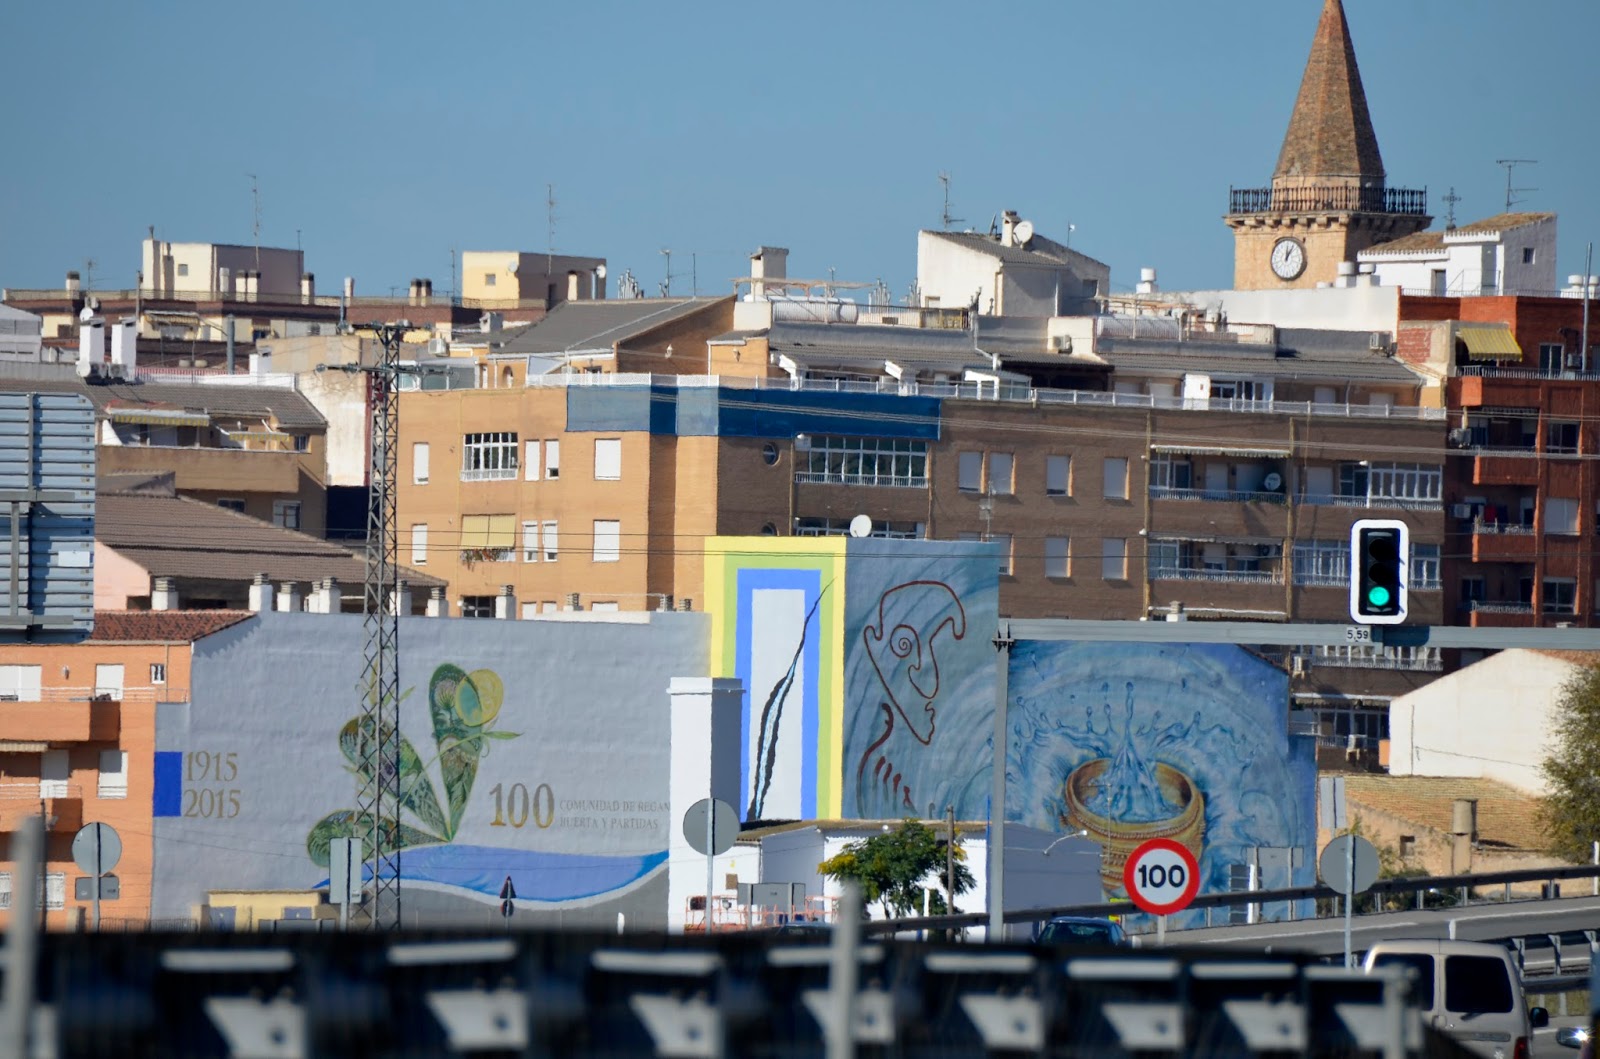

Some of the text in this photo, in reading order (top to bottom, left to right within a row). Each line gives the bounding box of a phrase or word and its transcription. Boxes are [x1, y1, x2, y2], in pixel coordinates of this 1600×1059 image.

[186, 751, 238, 782] 1915
[184, 788, 241, 819] 2015
[489, 782, 555, 829] 100
[560, 799, 620, 812] COMUNIDAD
[623, 800, 635, 812] DE
[560, 816, 659, 829] HUERTA Y PARTIDAS
[1138, 864, 1185, 888] 100
